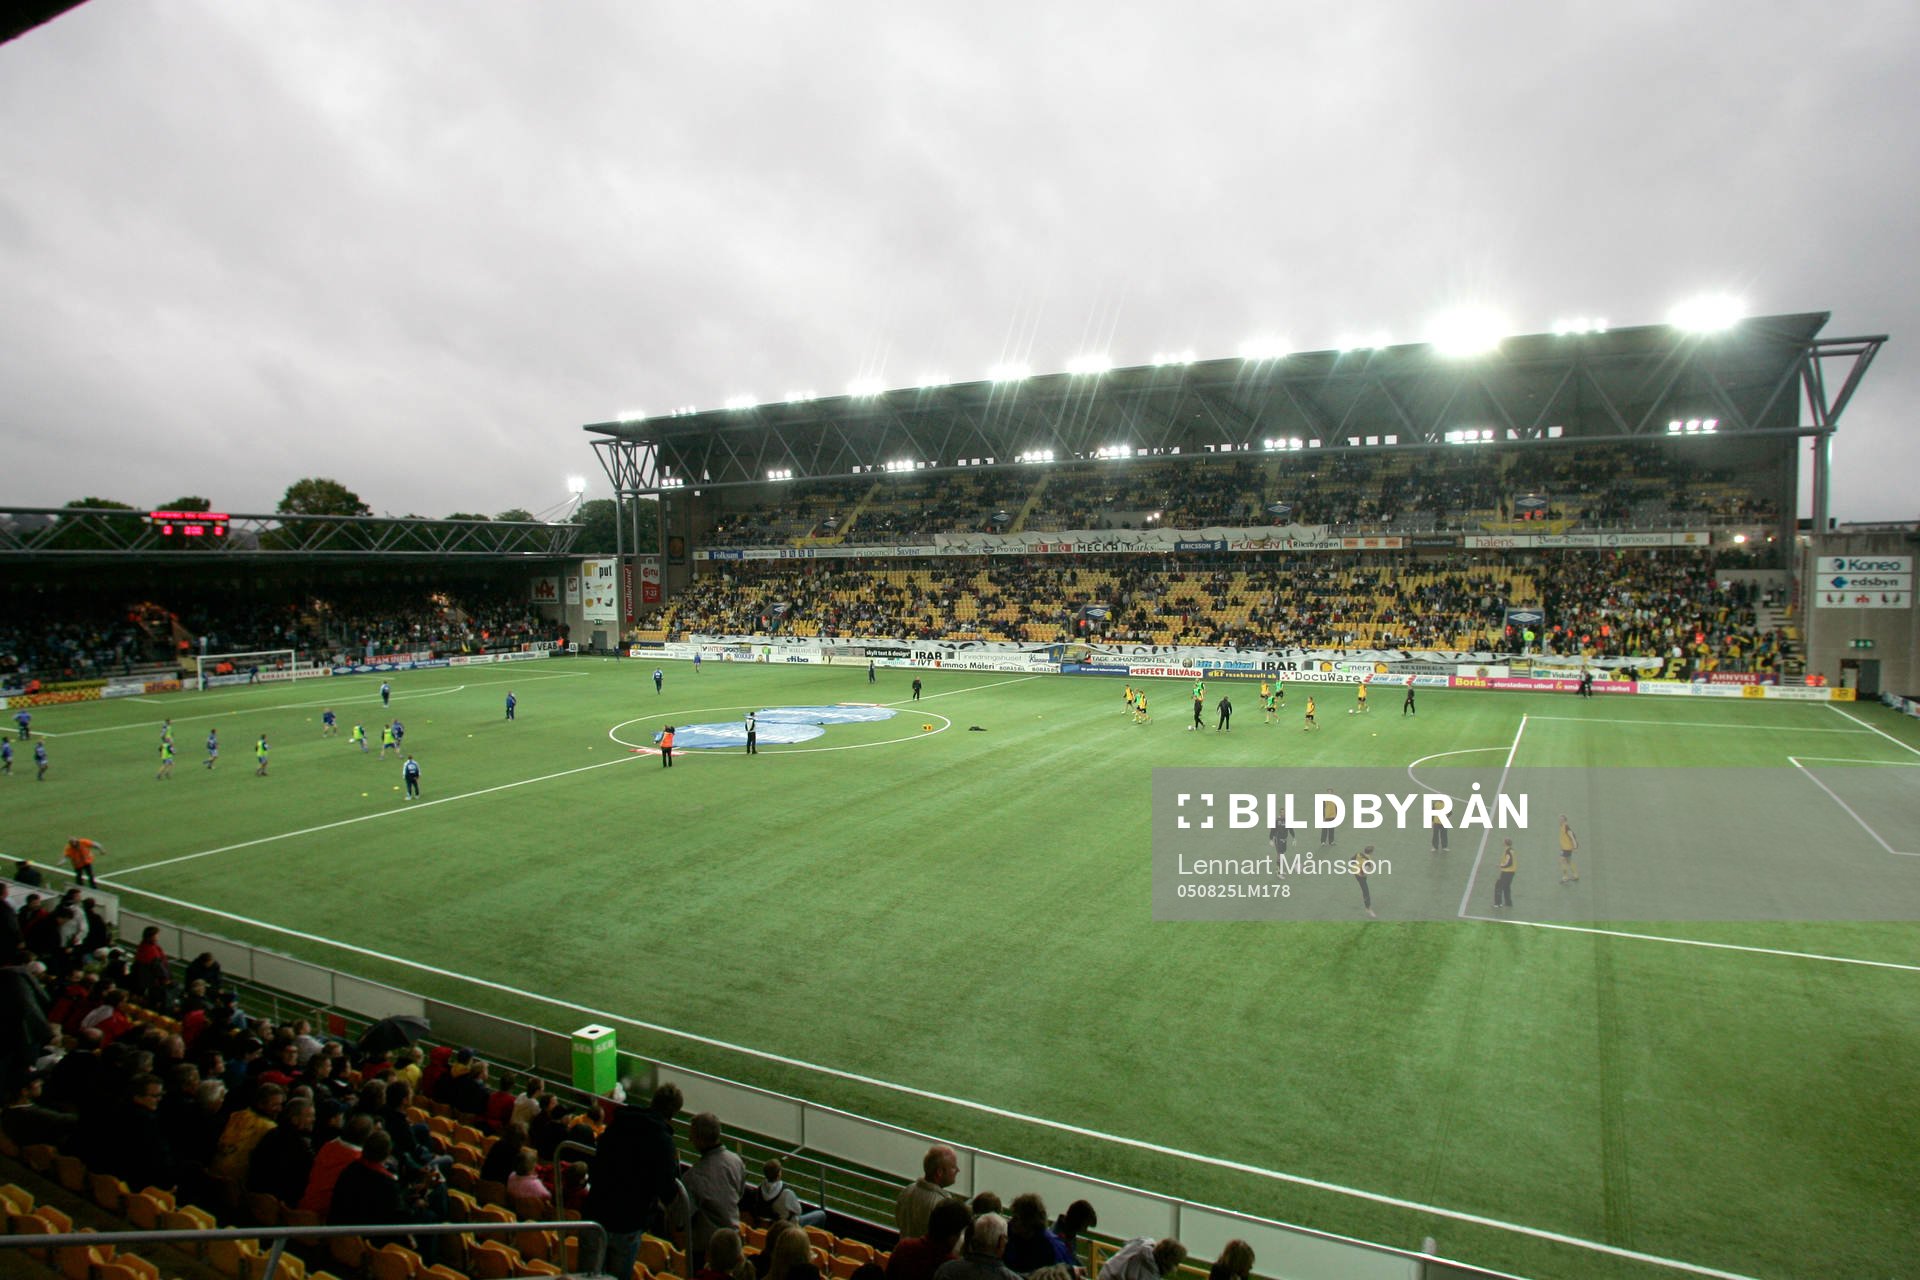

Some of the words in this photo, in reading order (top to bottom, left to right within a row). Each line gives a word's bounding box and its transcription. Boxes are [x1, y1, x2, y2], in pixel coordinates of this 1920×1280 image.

[1476, 536, 1514, 547] halens
[1849, 559, 1901, 571] Koneo
[1850, 577, 1899, 587] edsbyn
[1130, 668, 1165, 676] PERFECT
[1334, 662, 1371, 672] Cmera
[1295, 672, 1361, 683] DocuWare
